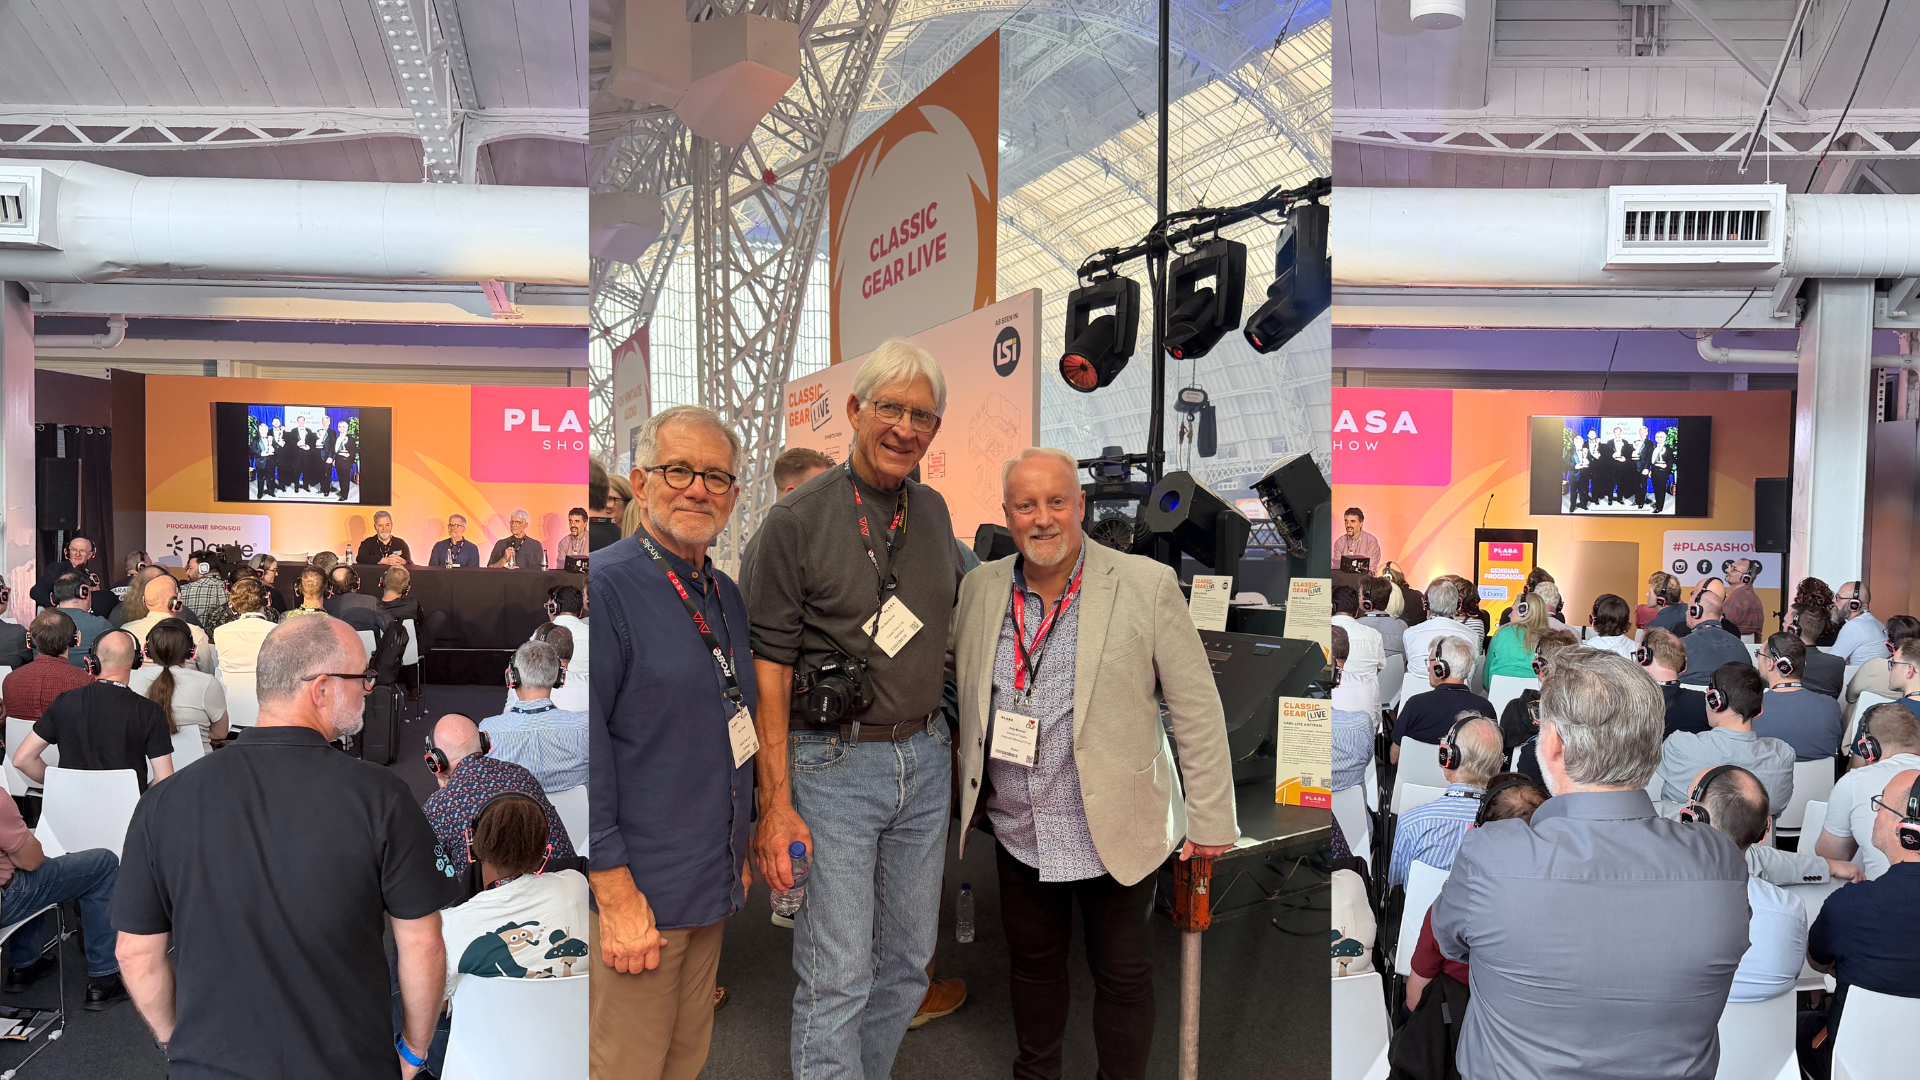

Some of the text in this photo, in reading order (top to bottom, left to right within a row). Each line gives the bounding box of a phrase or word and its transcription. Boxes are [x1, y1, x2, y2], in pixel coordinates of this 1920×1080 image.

[870, 202, 937, 262] CLASSIC
[862, 232, 946, 299] GEAR LIVE
[788, 383, 823, 408] CLASSIC
[504, 408, 583, 433] PLA
[789, 408, 810, 427] GEAR
[813, 397, 830, 422] LIVE
[1333, 410, 1418, 434] ASA
[542, 440, 584, 450] SHO
[1333, 440, 1378, 451] HOW
[190, 536, 254, 557] Dae
[642, 538, 662, 560] Anolis
[1283, 702, 1320, 710] CLASSIC
[1309, 710, 1326, 719] LIVE
